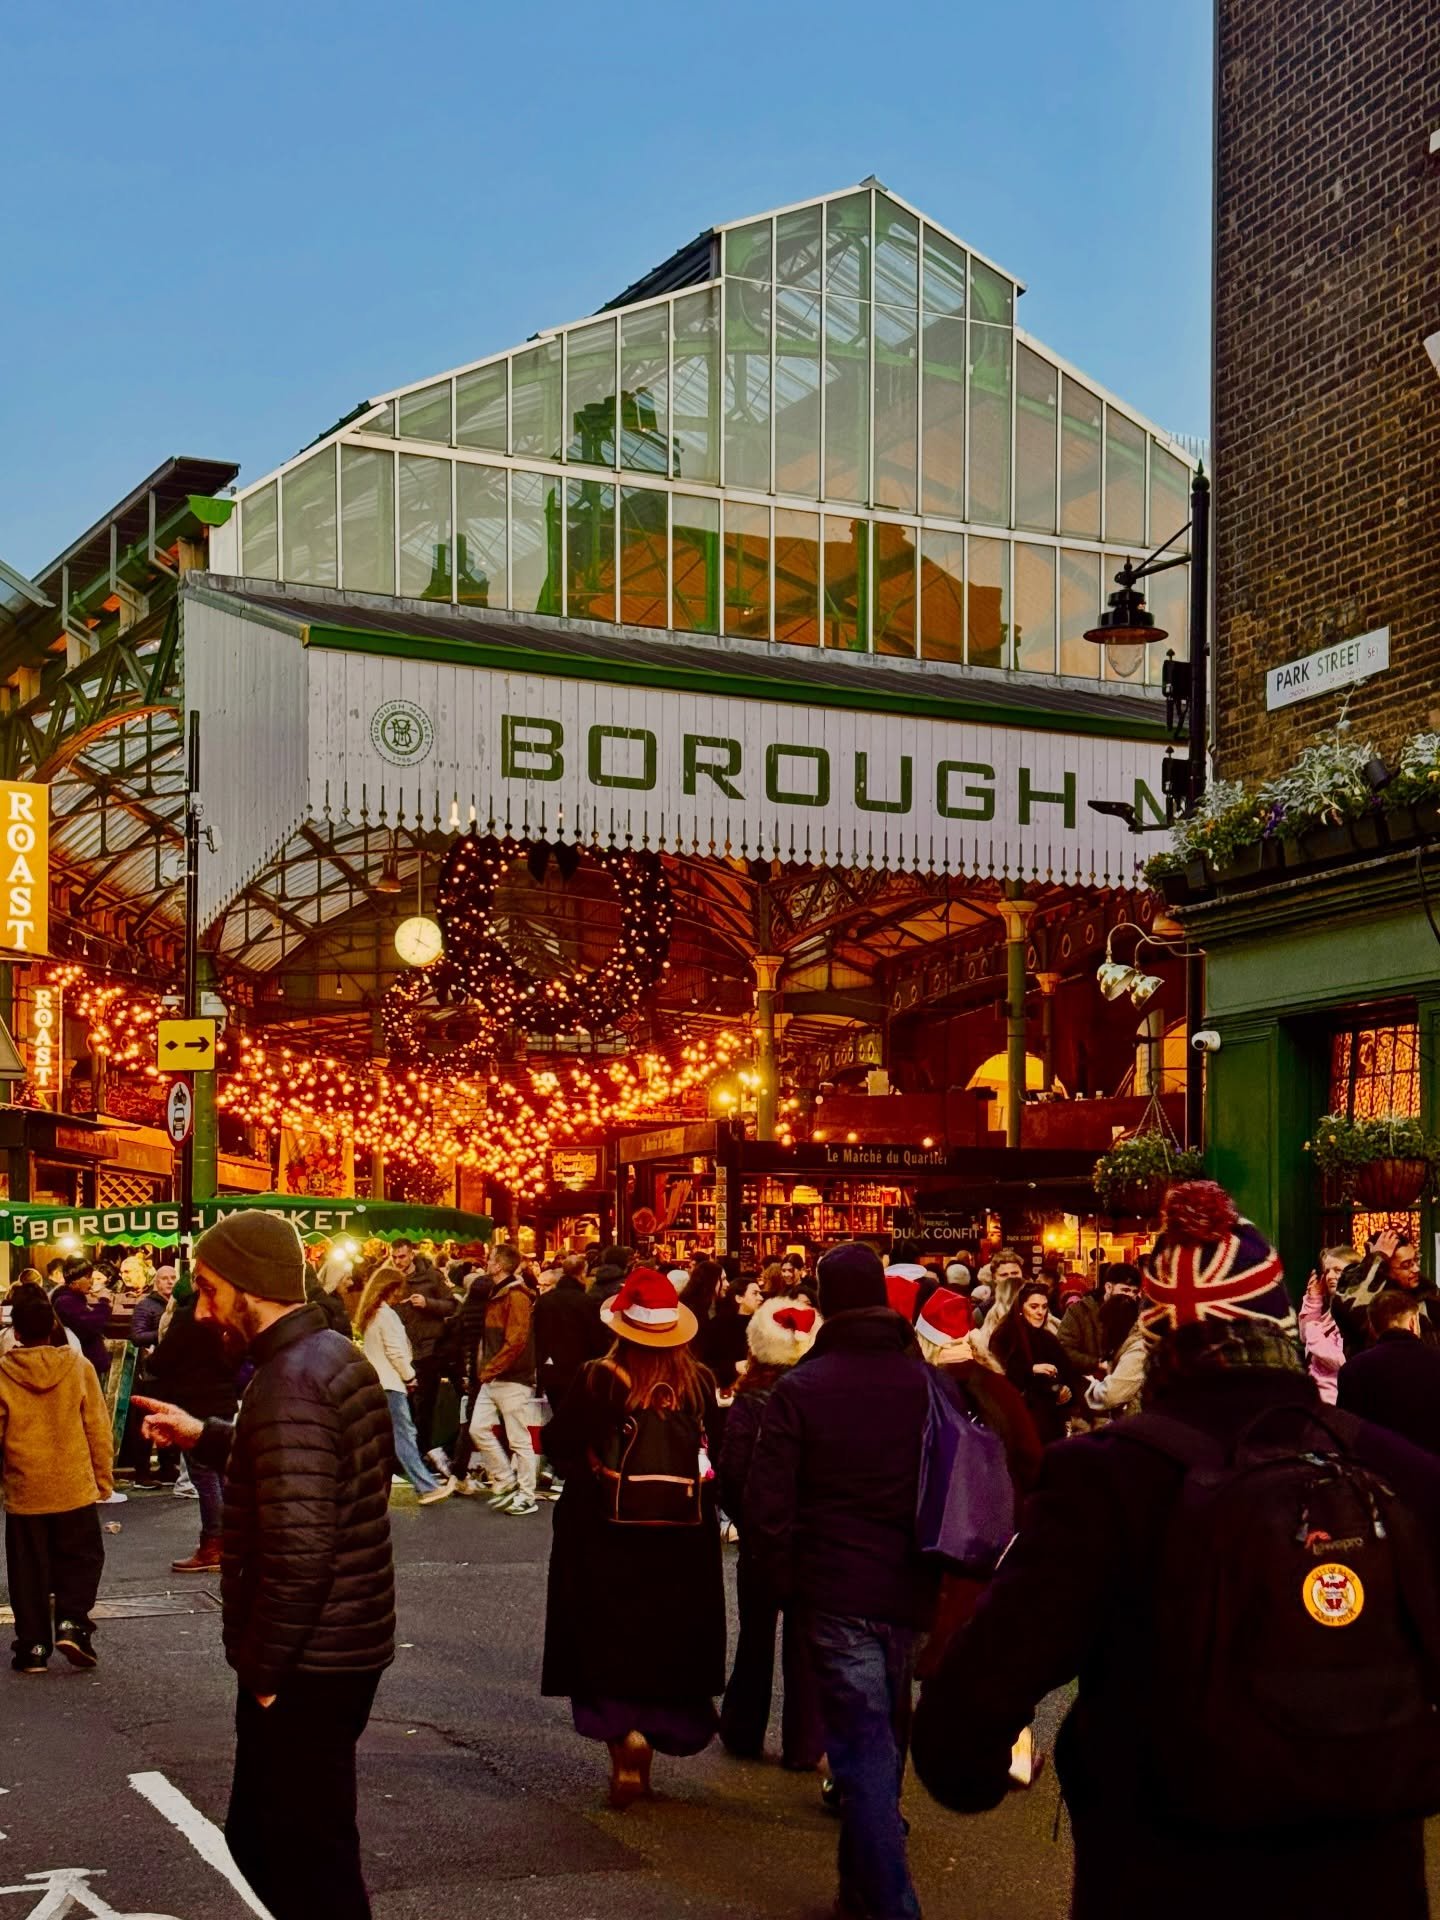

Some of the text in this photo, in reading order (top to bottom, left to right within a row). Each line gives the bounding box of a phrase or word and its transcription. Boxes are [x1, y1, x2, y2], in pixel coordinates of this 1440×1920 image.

[1276, 661, 1310, 692] PARK
[1317, 642, 1361, 677] STREET
[373, 703, 430, 747] BOROUGH MARKET
[501, 714, 1077, 830] BOROUGH
[6, 790, 36, 951] ROAST
[34, 989, 54, 1087] ROAST
[827, 1148, 838, 1162] Le
[843, 1148, 882, 1163] Marché
[886, 1149, 899, 1164] du
[217, 1208, 354, 1231] MKET
[893, 1227, 979, 1240] DUCK CONFIT
